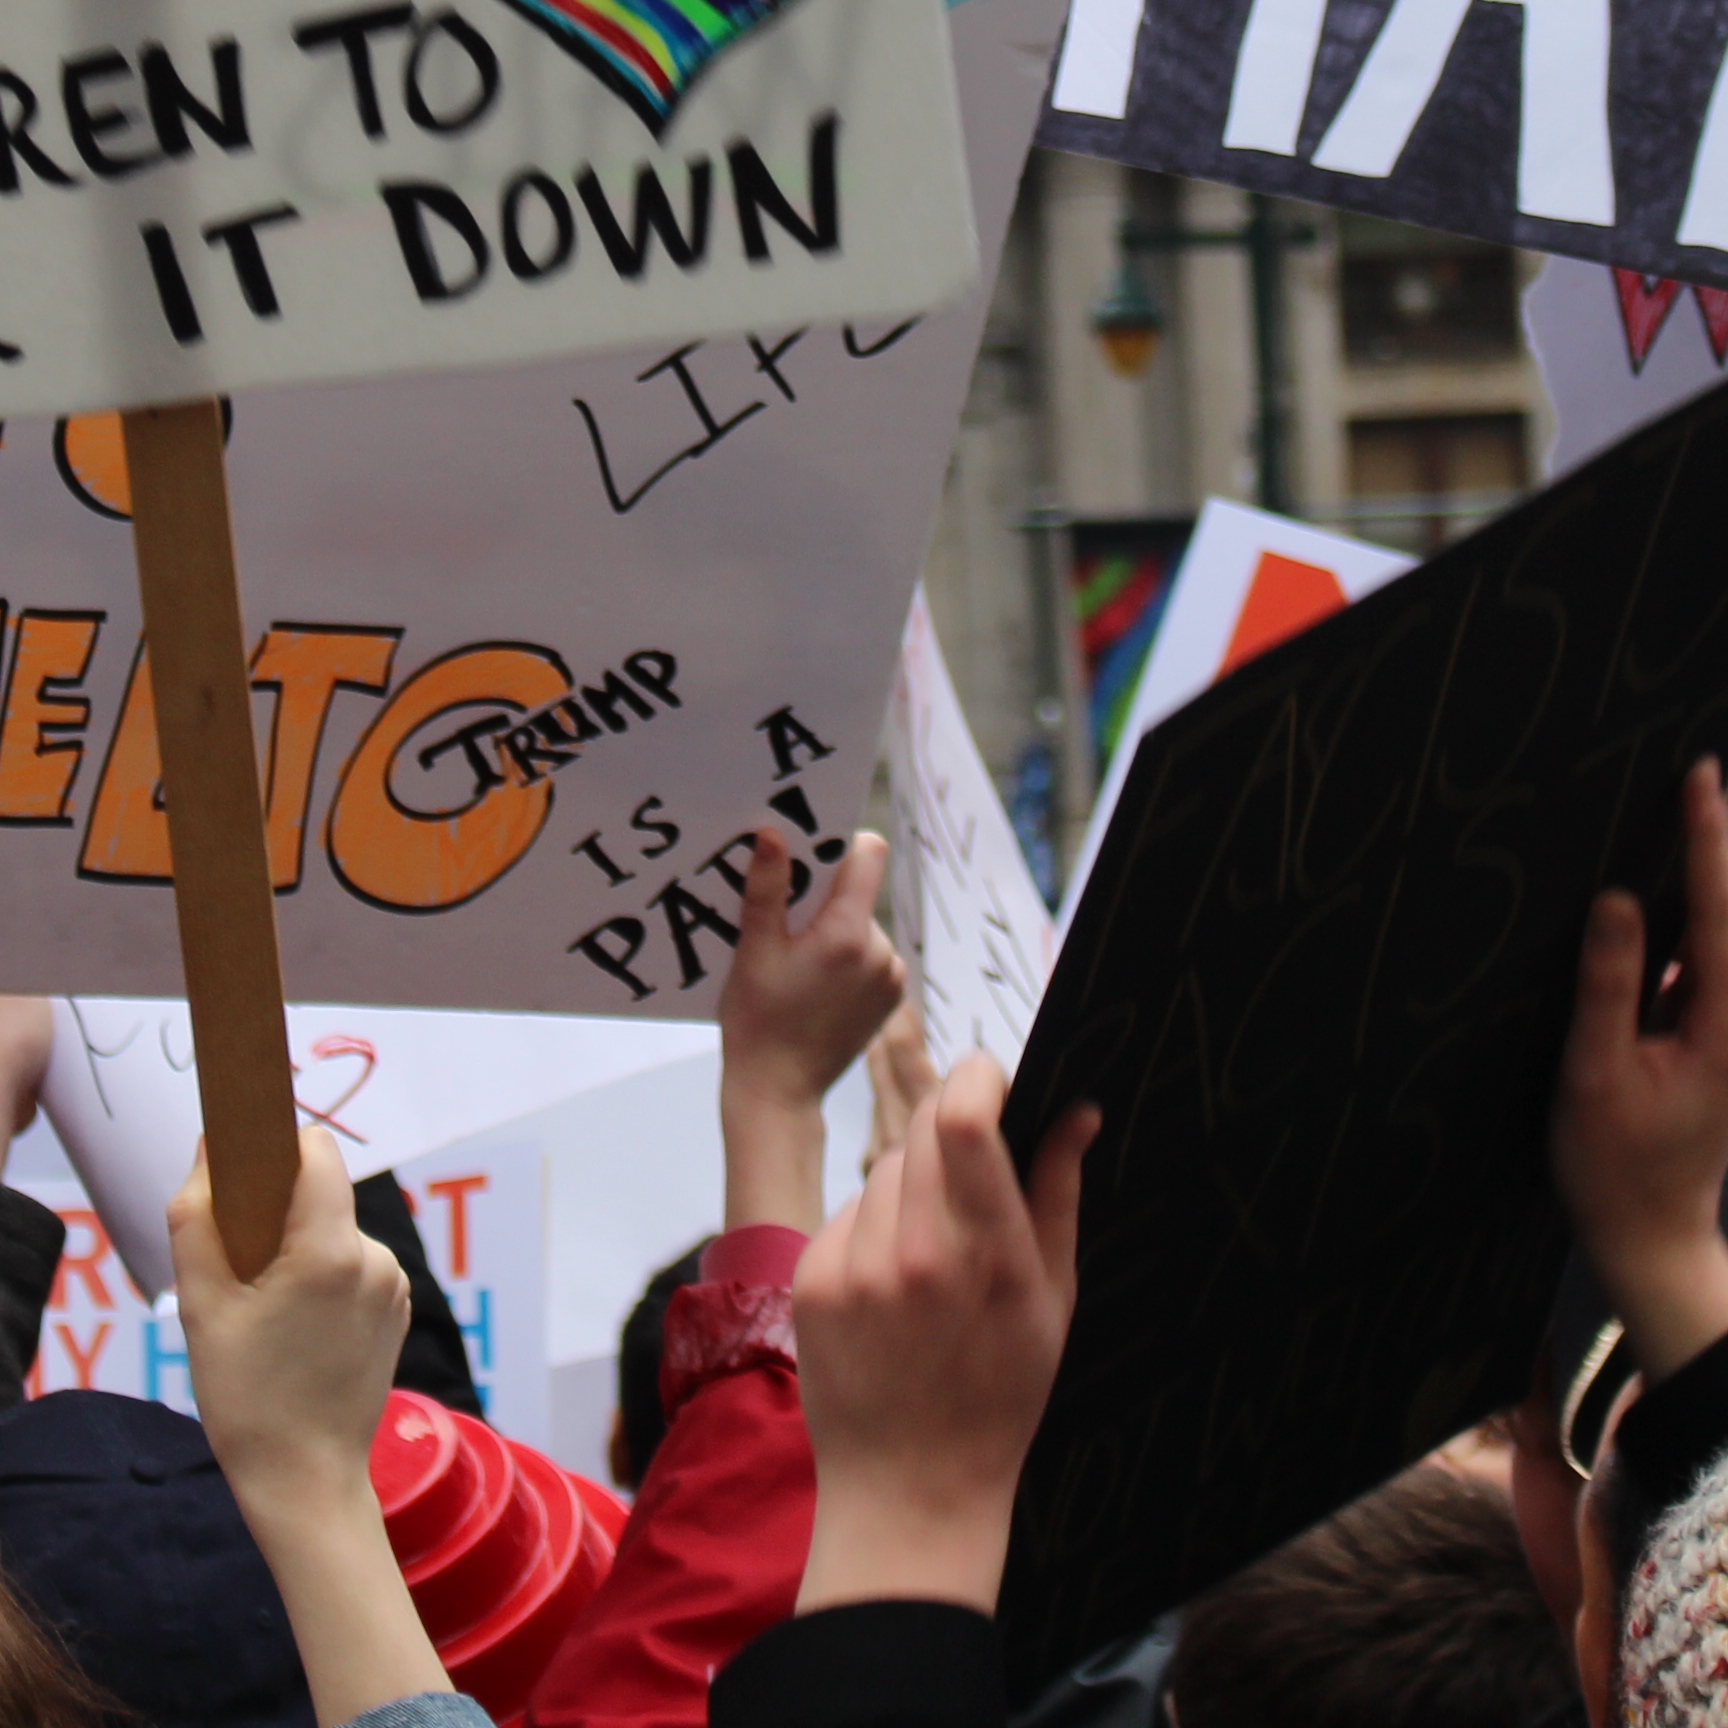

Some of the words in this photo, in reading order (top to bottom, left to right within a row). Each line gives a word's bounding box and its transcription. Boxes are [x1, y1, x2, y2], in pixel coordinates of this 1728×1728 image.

[294, 0, 500, 140] TO
[140, 202, 303, 346] IT
[380, 114, 839, 303] DOWN
[418, 646, 685, 799] TRUMP
[755, 704, 836, 782] A
[571, 794, 683, 889] IS
